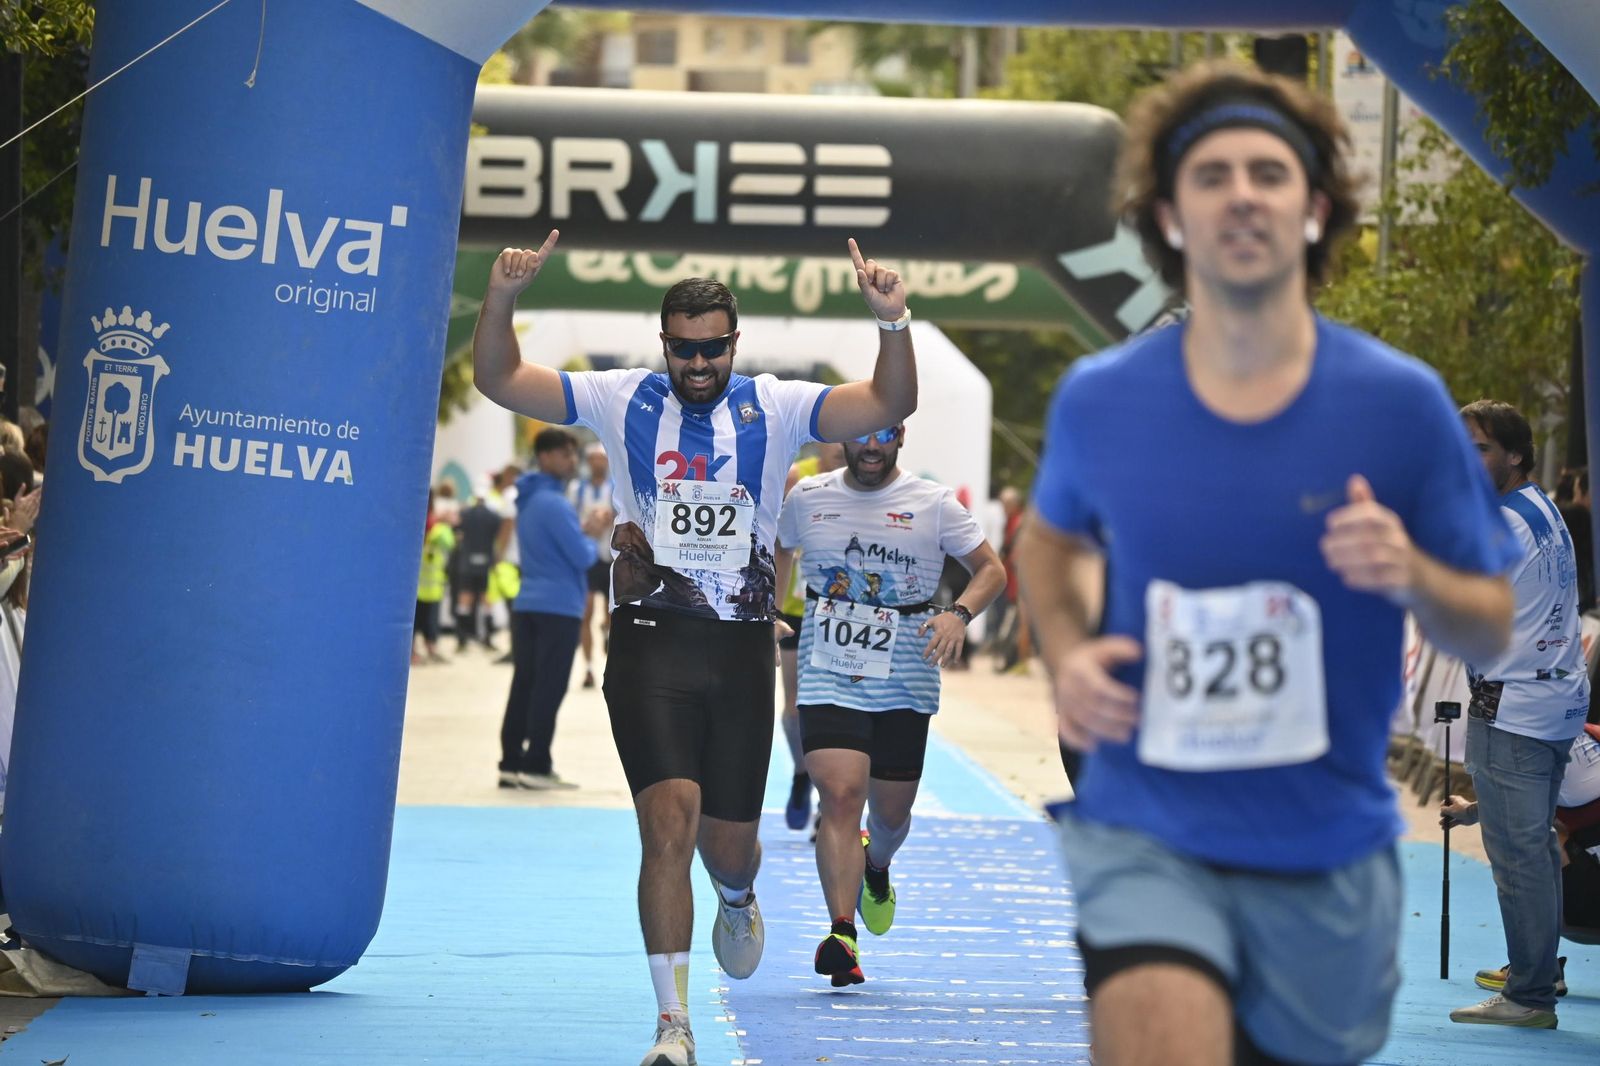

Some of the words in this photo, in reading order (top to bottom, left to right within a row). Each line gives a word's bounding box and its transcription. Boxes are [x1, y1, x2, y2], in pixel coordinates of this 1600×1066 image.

[100, 174, 385, 277] Huelva
[275, 279, 377, 314] original
[137, 393, 149, 437] CUSTODIA
[178, 402, 332, 437] Ayuntamiento
[336, 420, 360, 441] de
[172, 432, 354, 486] HUELVA
[656, 450, 732, 482] 21K
[671, 504, 737, 537] 892
[679, 550, 722, 562] Huelva
[819, 618, 892, 652] 1042
[830, 657, 864, 670] Huelva
[1166, 632, 1285, 700] 828
